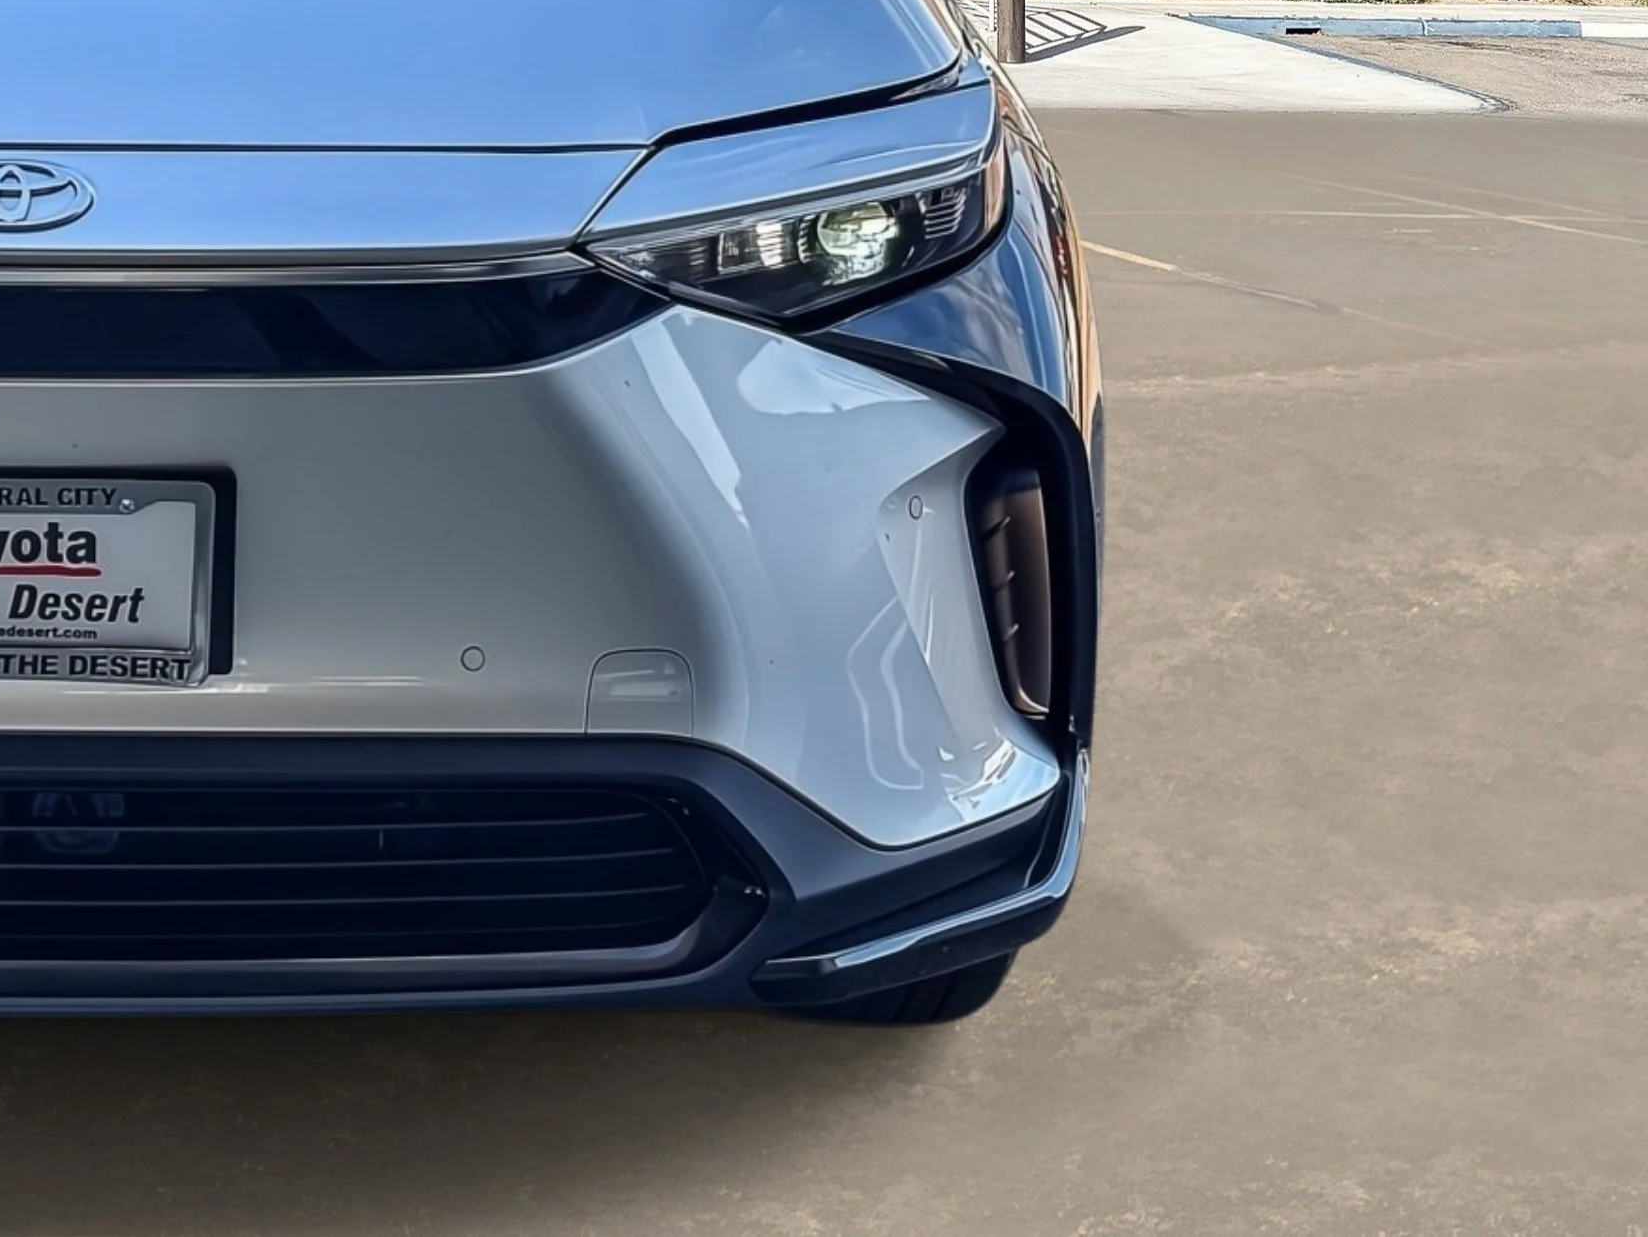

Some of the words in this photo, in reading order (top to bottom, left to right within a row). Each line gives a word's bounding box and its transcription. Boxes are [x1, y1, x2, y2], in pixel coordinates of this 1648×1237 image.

[57, 487, 119, 507] CITY
[8, 584, 145, 624] Desert
[0, 654, 64, 677] THE
[69, 656, 191, 681] DESERT
